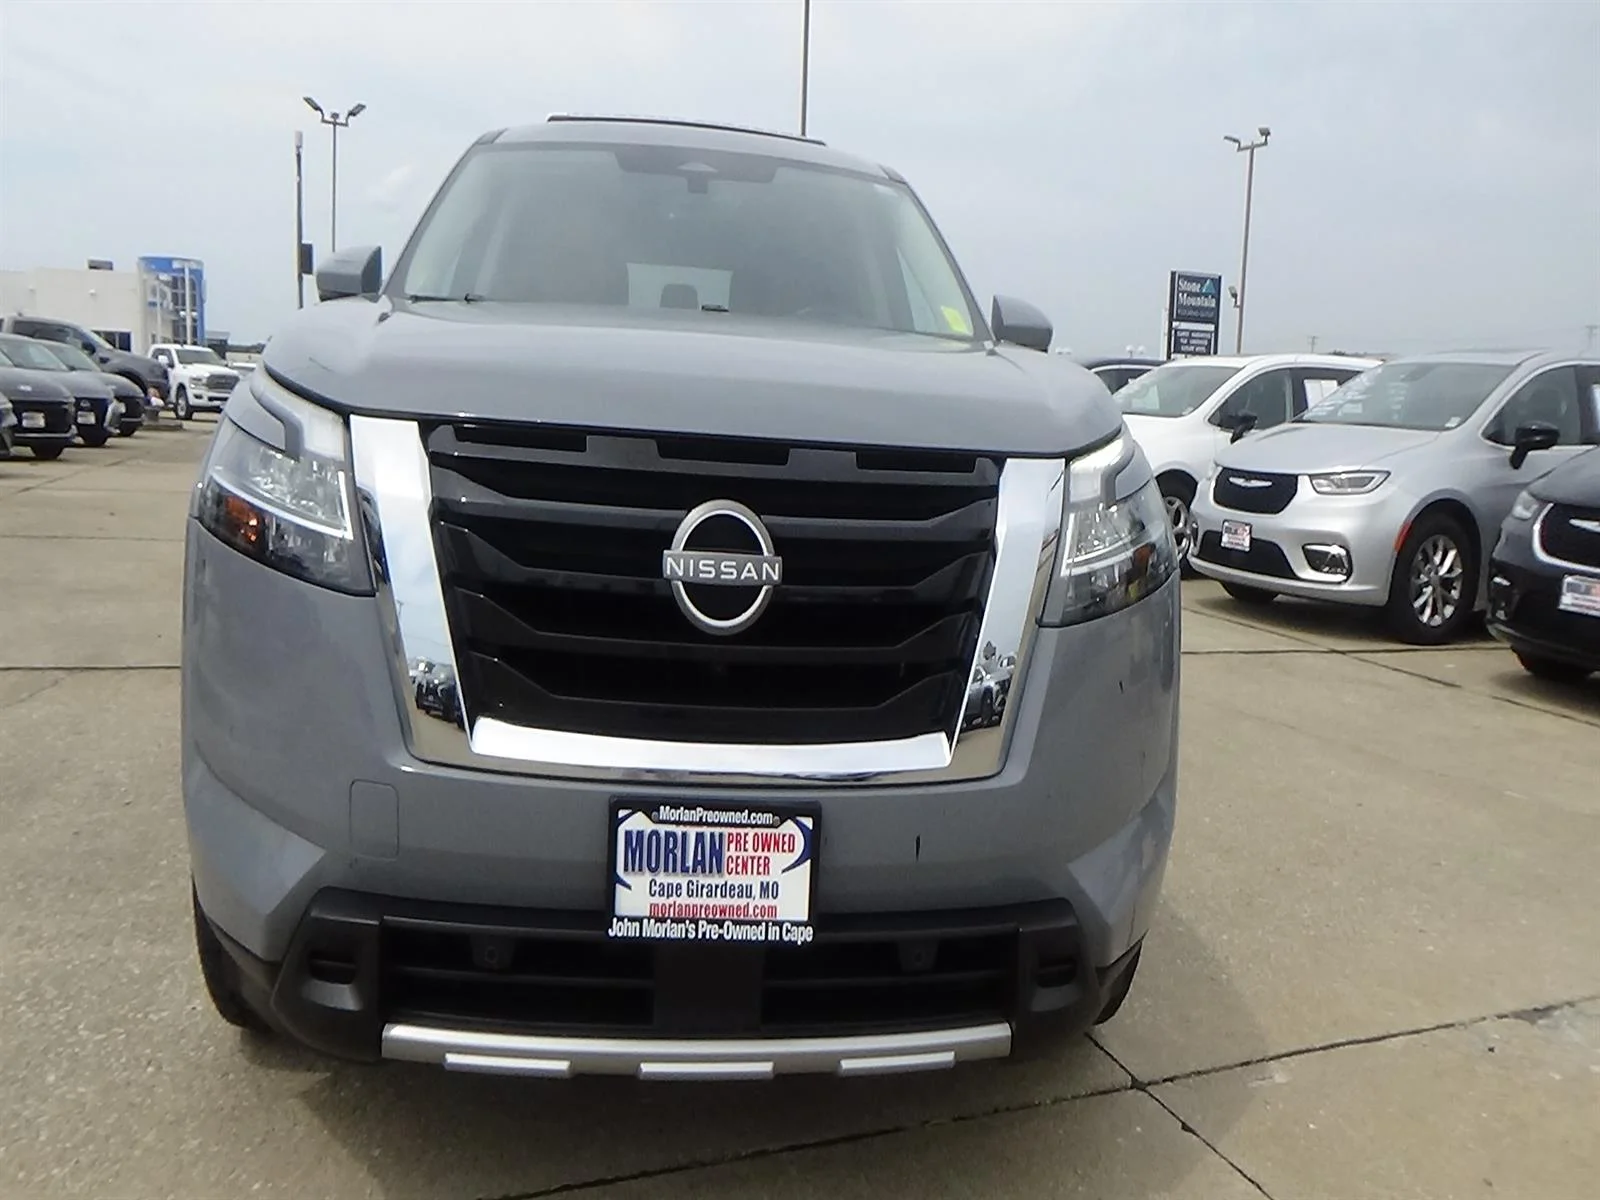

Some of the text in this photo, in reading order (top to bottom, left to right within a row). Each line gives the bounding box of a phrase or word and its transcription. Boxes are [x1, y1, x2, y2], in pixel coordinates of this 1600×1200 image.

[666, 556, 780, 581] NISSAN
[659, 805, 773, 825] MorlanPreowned.com
[623, 829, 724, 874] MORLAN
[727, 832, 796, 854] PRE OWNED
[725, 856, 770, 876] CENTER
[648, 878, 779, 901] Cape Girardeau, MO
[649, 900, 778, 919] morlanpreowned.com
[608, 917, 814, 946] John Morlan's Pre-Owned in Cape
